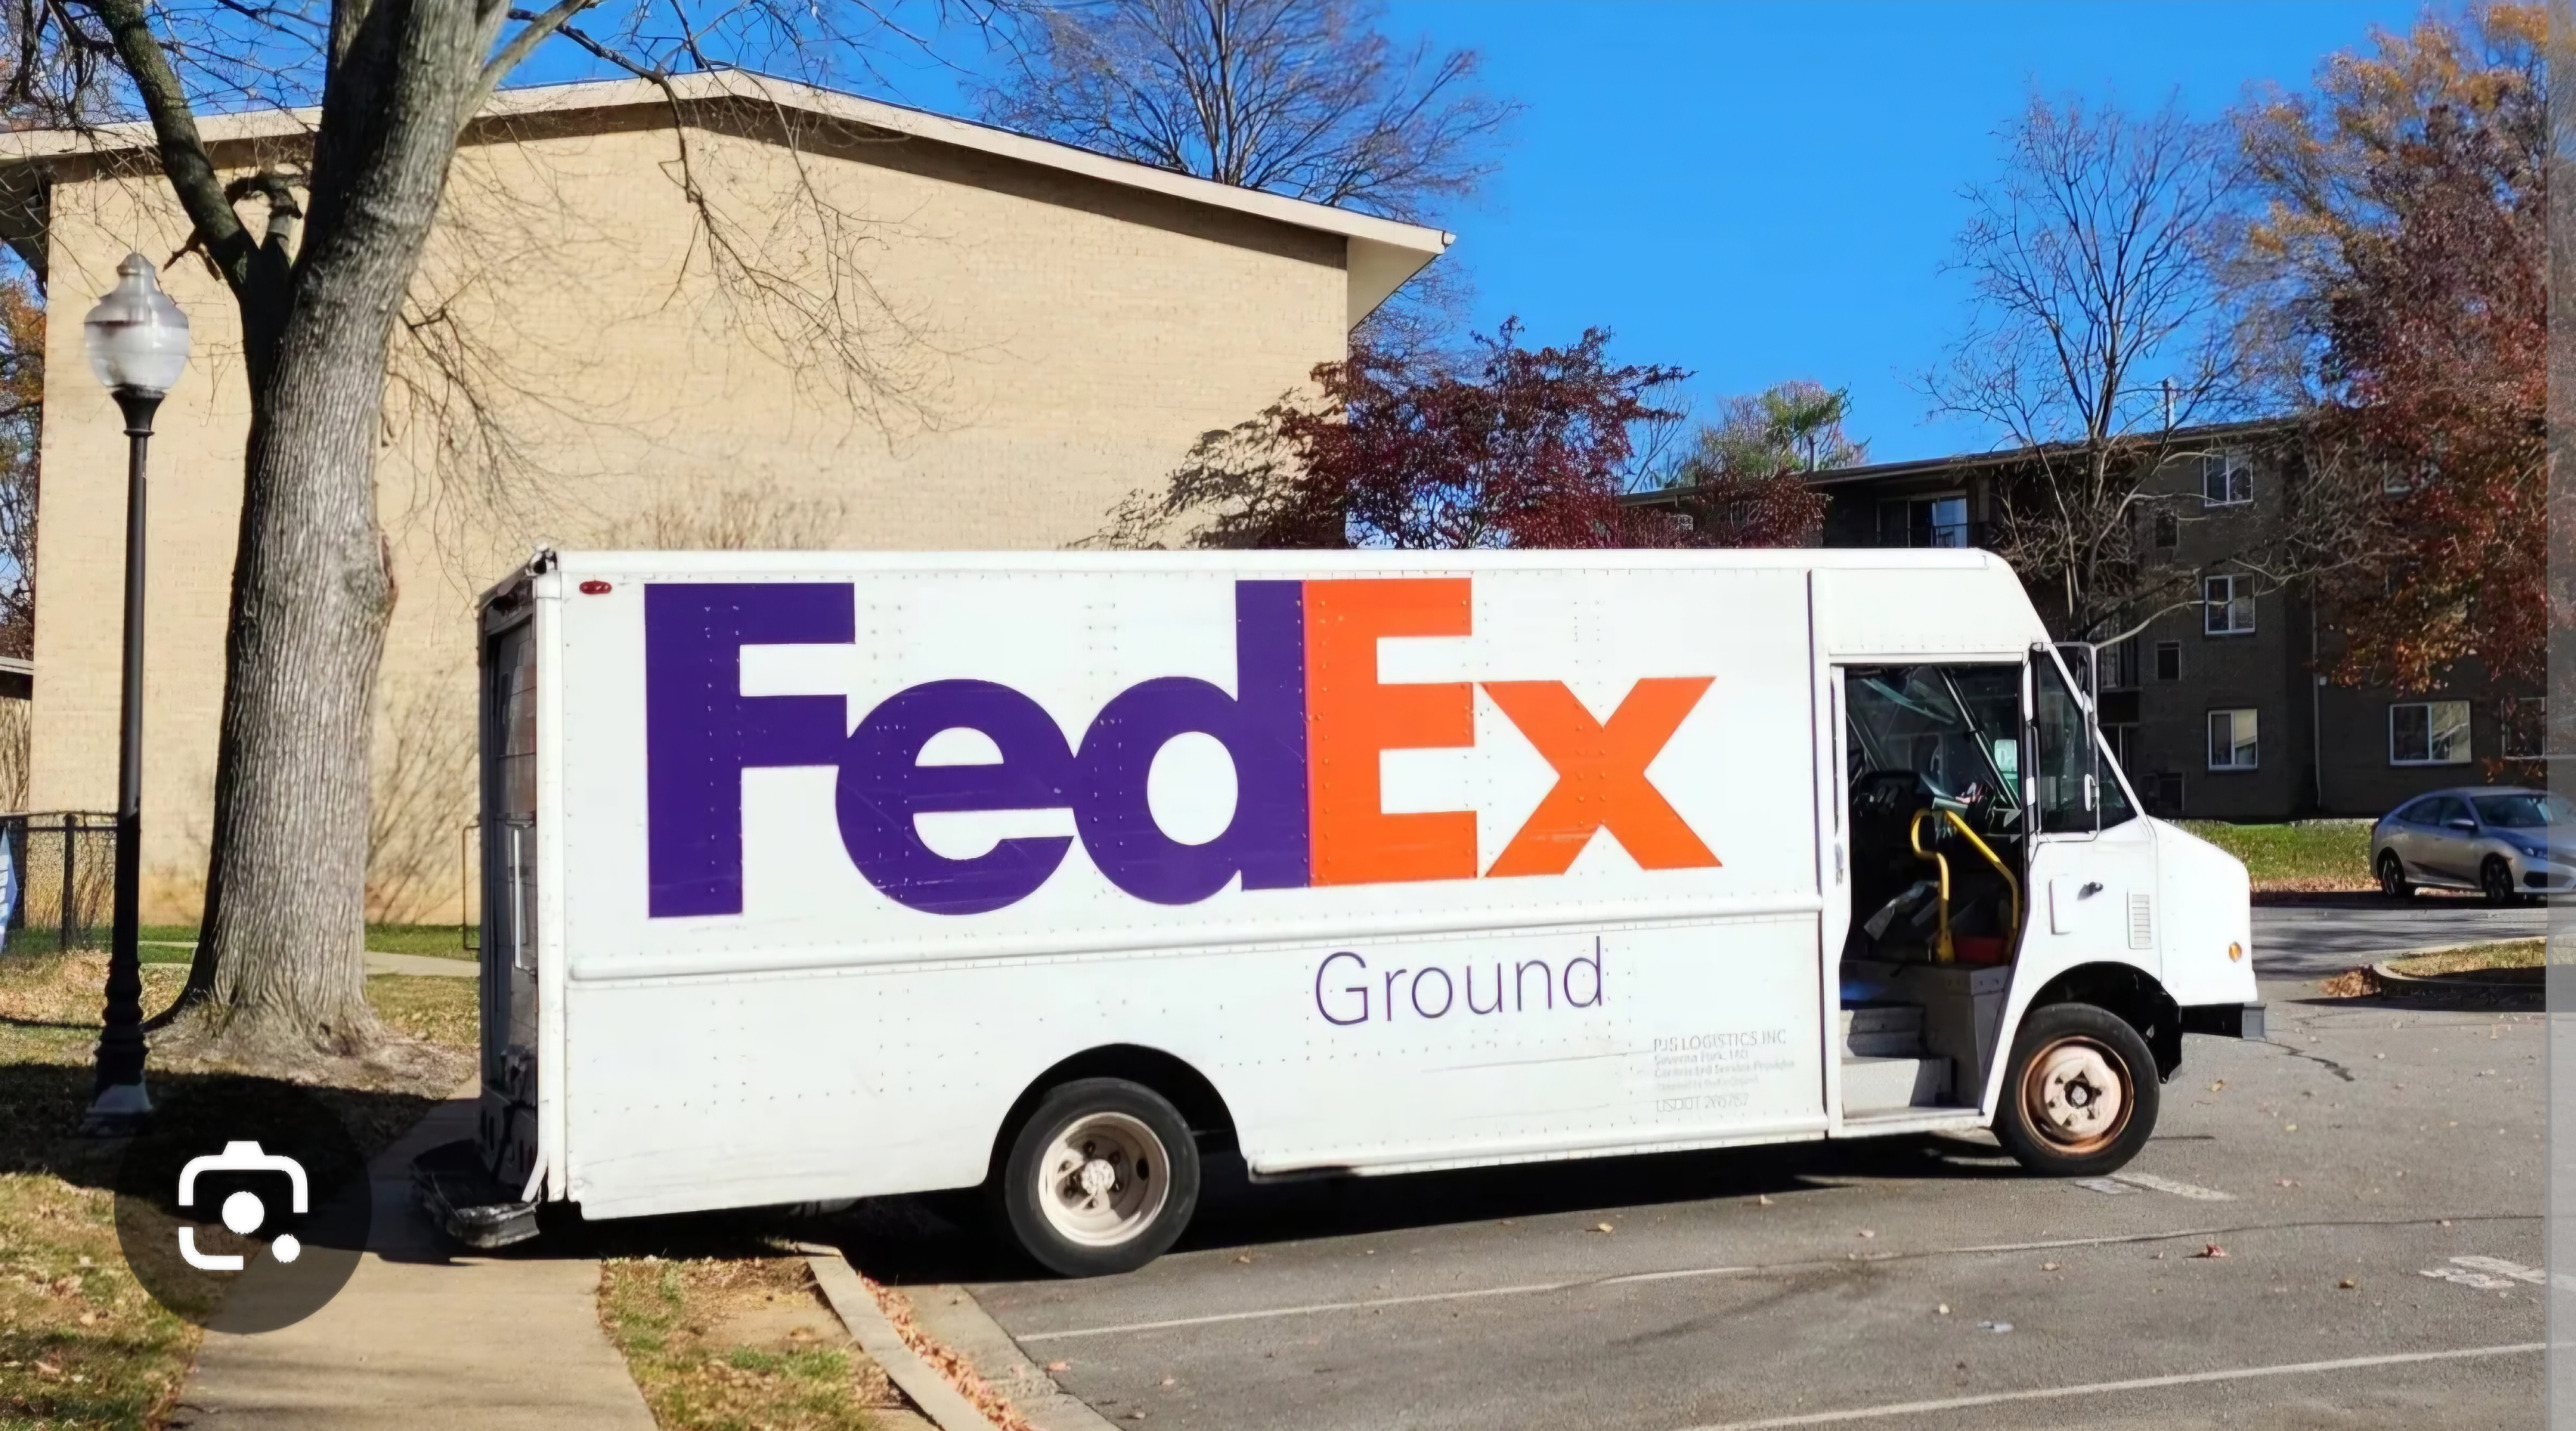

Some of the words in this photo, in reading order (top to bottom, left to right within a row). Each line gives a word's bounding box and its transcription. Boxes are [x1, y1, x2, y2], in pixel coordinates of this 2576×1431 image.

[645, 578, 1722, 919] FedEx
[1316, 936, 1602, 1025] Ground
[1654, 1038, 1678, 1052] PJS
[1682, 1031, 1757, 1050] LOGISTICS
[1762, 1029, 1786, 1045] INC
